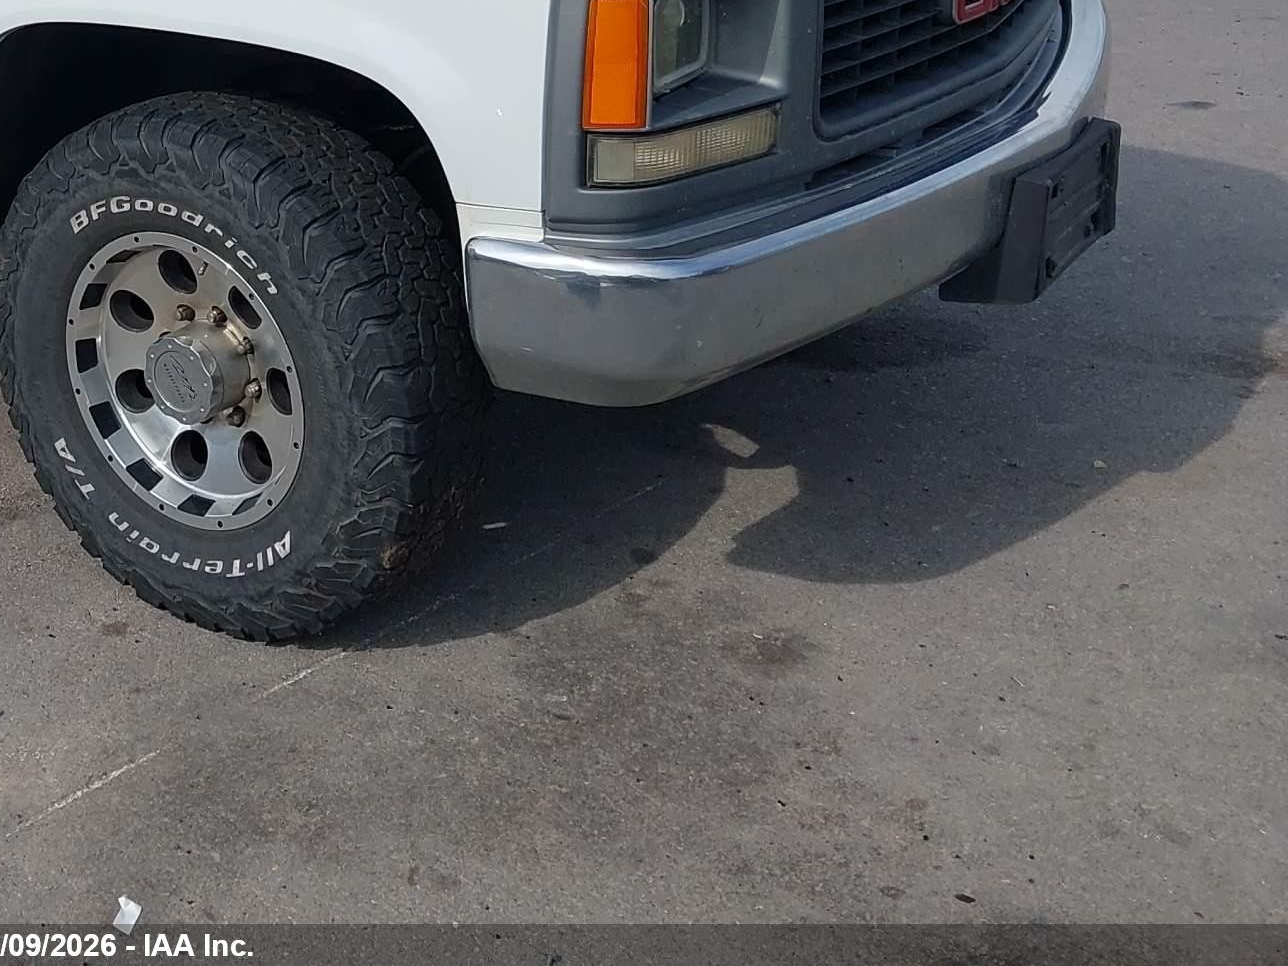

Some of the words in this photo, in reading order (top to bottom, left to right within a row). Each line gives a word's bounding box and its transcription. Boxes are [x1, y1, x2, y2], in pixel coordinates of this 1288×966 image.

[69, 195, 278, 295] BFGoodrich
[54, 437, 96, 500] T/A
[108, 511, 292, 578] All-Terrain
